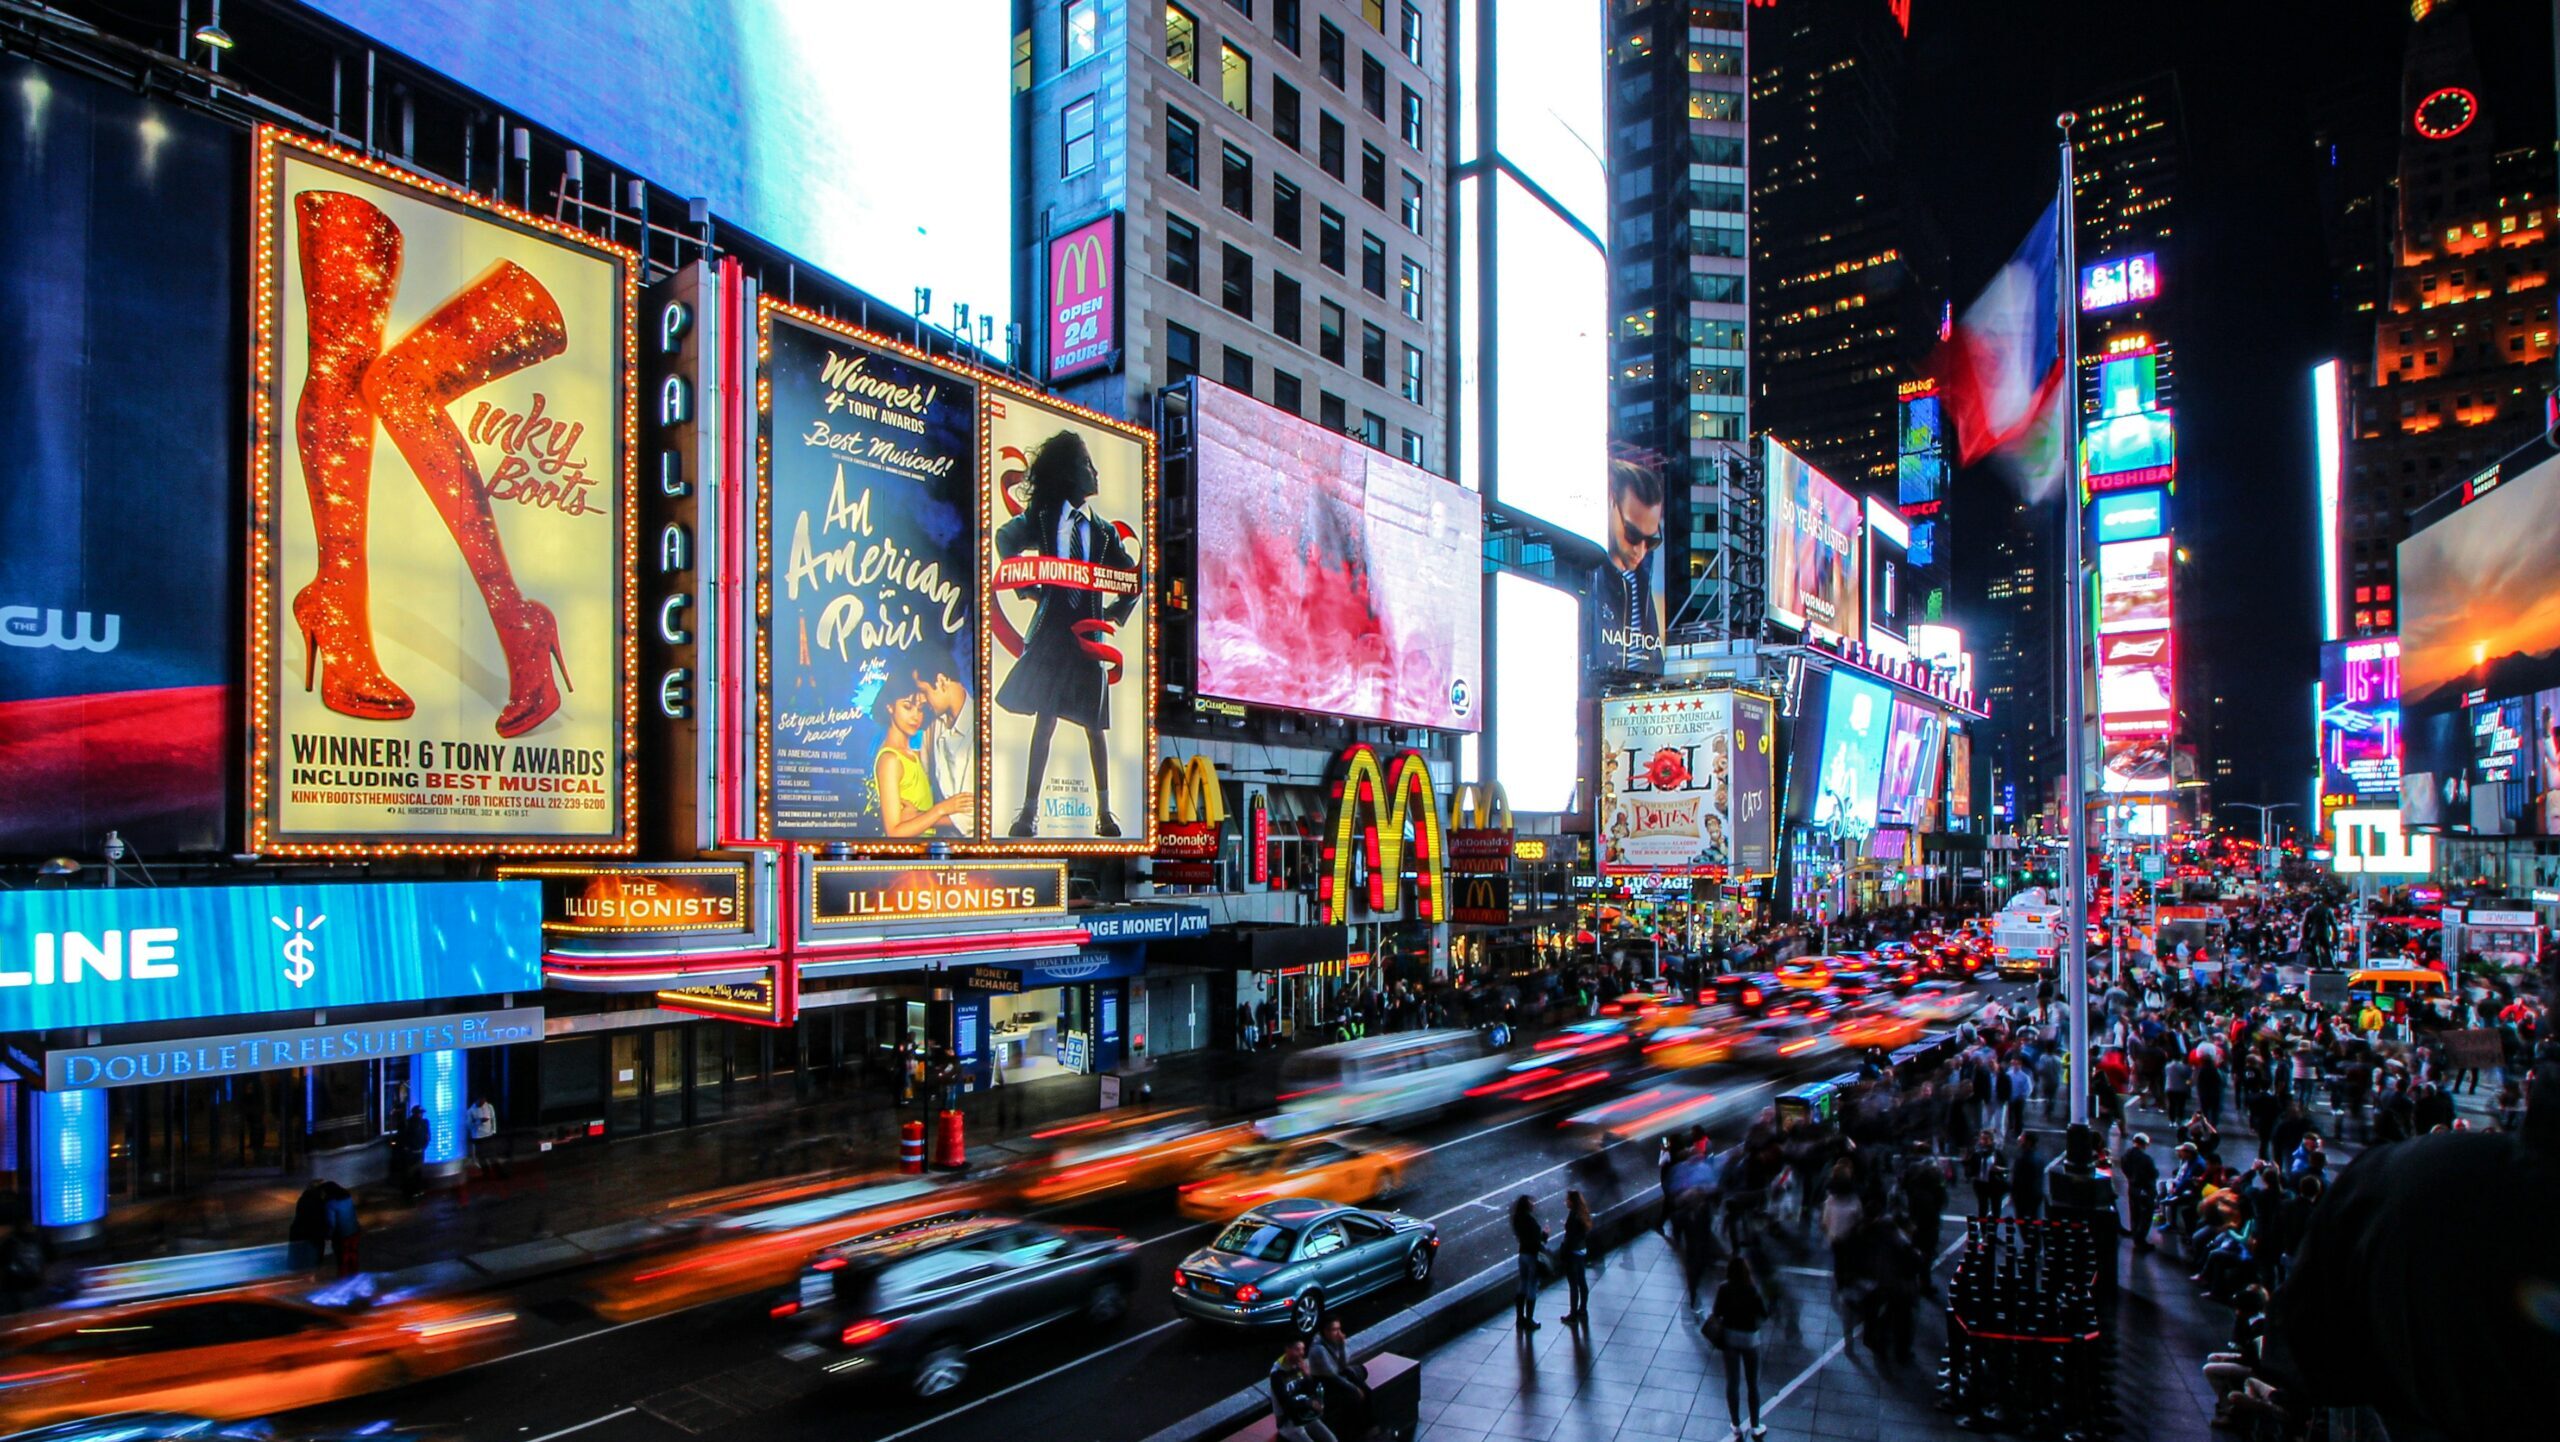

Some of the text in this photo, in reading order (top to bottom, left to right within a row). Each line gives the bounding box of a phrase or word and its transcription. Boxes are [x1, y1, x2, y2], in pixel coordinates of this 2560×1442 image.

[1059, 296, 1103, 323] OPEN
[1064, 315, 1097, 349] 24
[1054, 340, 1108, 370] HOURS
[821, 350, 937, 415] Winner!
[825, 391, 925, 435] 4 TONY AWARDS
[803, 421, 864, 455] Best
[868, 437, 954, 477] Musical!
[485, 456, 607, 516] Boots
[2090, 465, 2171, 491] TOSHIBA
[2473, 464, 2501, 486] MARRIOTT
[2473, 476, 2499, 496] MARQUIS
[661, 300, 693, 718] PALACE
[823, 463, 873, 537] An
[1783, 499, 1849, 556] 50 YEARS LISTED
[785, 511, 965, 633] American
[1000, 561, 1090, 585] FINAL MONTHS
[1093, 566, 1138, 583] SEE IT BEFORE
[1093, 580, 1138, 593] JANUARY 1
[1800, 589, 1835, 618] VORNADO
[0, 605, 120, 653] CW
[12, 622, 37, 632] THE
[816, 594, 923, 662] Paris
[1601, 628, 1662, 651] NAUTICA
[795, 712, 825, 736] your
[826, 706, 863, 724] heart
[1611, 710, 1722, 726] THE FUNNIEST MUSICAL
[802, 726, 853, 746] racing
[1627, 727, 1639, 736] IN
[1642, 726, 1664, 736] 400
[292, 734, 605, 776] WINNER! 6 TONY AWARDS
[292, 769, 605, 794] INCLUDING BEST MUSICAL
[292, 791, 605, 810] KINKYBOOTSTHEMUSICAL.COM FOR TICKETS CALL 212-239-6200
[1044, 798, 1092, 817] Matilda
[1742, 789, 1762, 822] CATS
[1813, 786, 1870, 857] Disney
[621, 884, 657, 896] THE
[937, 873, 967, 885] THE
[565, 897, 734, 917] ILLUSIONISTS
[848, 887, 1036, 914] ILLUSIONISTS
[1122, 917, 1172, 935] MONEY
[1181, 915, 1208, 930] ATM
[1034, 953, 1110, 968] MONEY EXCHANGE
[969, 978, 1019, 991] EXCHANGE
[976, 967, 1008, 979] MONEY
[462, 1018, 488, 1031] BY
[462, 1025, 533, 1044] HILTON
